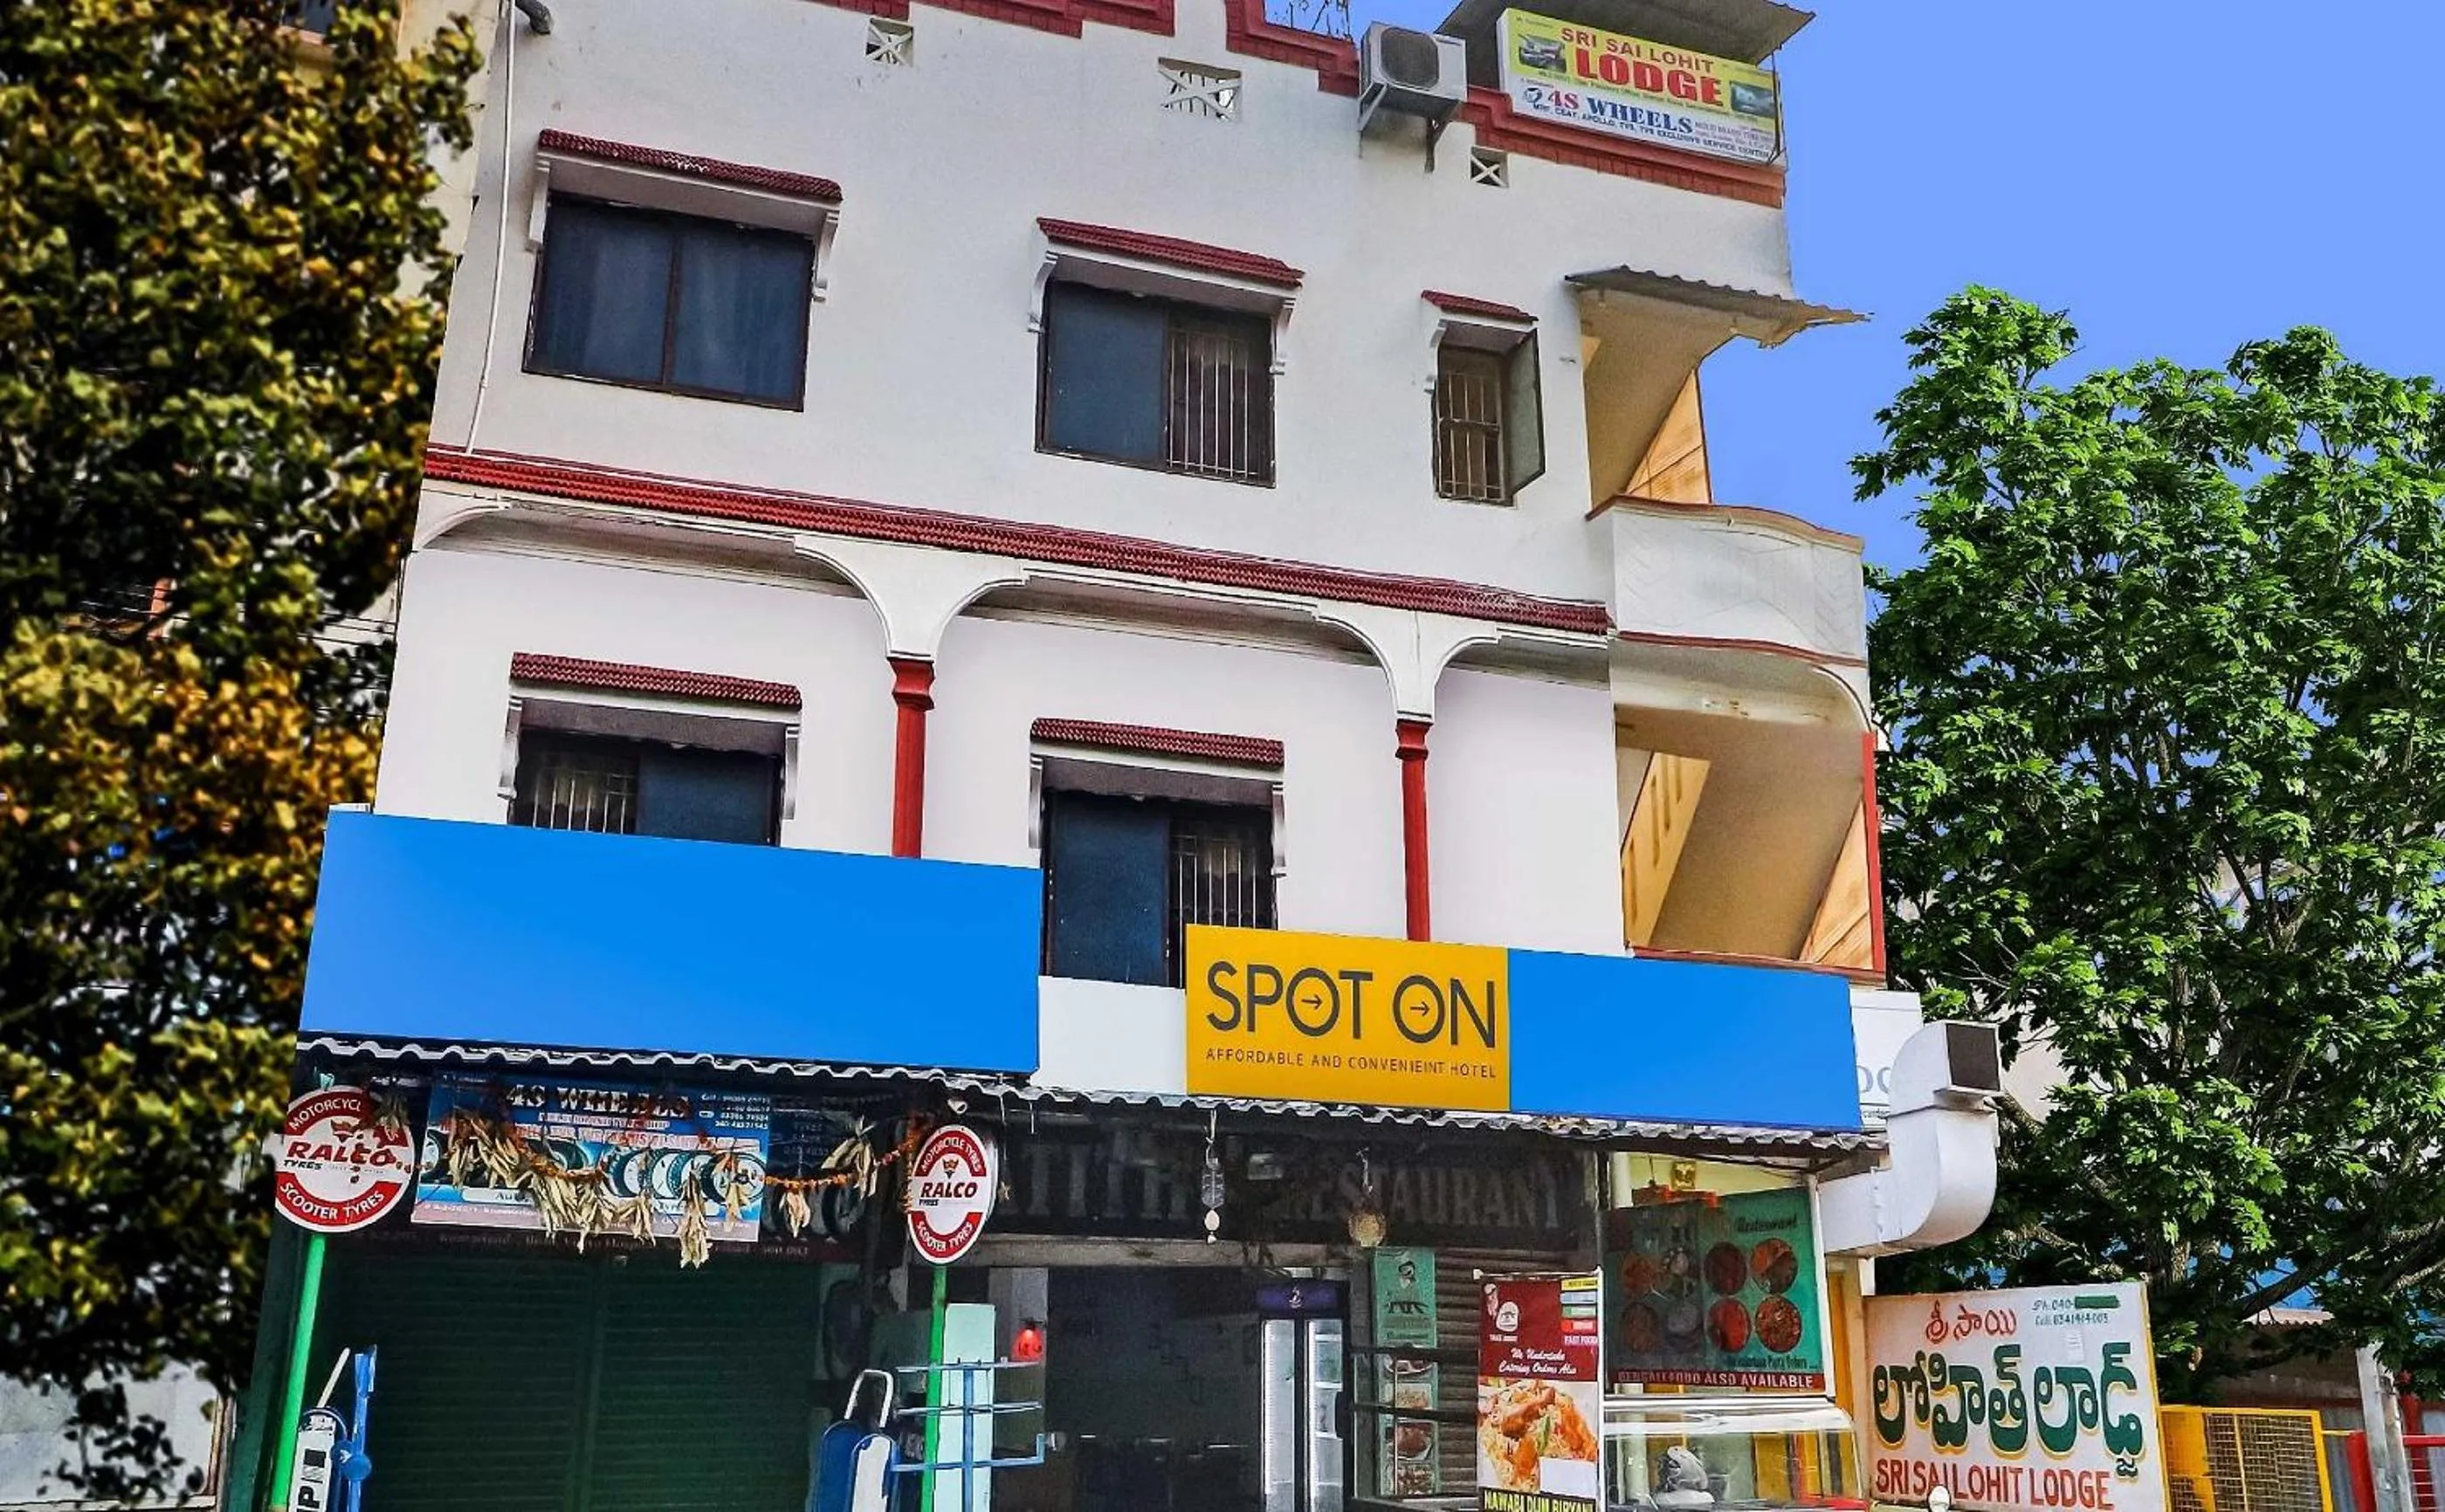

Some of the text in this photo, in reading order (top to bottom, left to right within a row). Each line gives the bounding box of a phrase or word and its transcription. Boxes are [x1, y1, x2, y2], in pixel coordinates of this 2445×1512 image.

[1561, 27, 1597, 48] SRI
[1606, 38, 1642, 58] SAI
[1650, 49, 1715, 73] LOHIT
[1575, 48, 1724, 107] LODGE
[1548, 89, 1580, 110] 4S
[1586, 96, 1694, 134] WHEELS
[1205, 960, 1496, 1048] SPOT ON
[1206, 1048, 1304, 1067] AFFORDABLE
[1311, 1054, 1342, 1069] AND
[1450, 1063, 1497, 1079] HOTEL
[283, 1159, 323, 1171] TYRES
[921, 1136, 984, 1173] MOTORCYCLE TYRES
[279, 1181, 385, 1220] SCOOTER TYRES
[920, 1181, 979, 1199] RALCO
[916, 1220, 974, 1252] SCOOTER TYRES
[1705, 1373, 1737, 1386] ALSO
[1741, 1373, 1814, 1389] AVAILABLE
[1877, 1459, 2116, 1511] SRI SAI LOHIT LODGE
